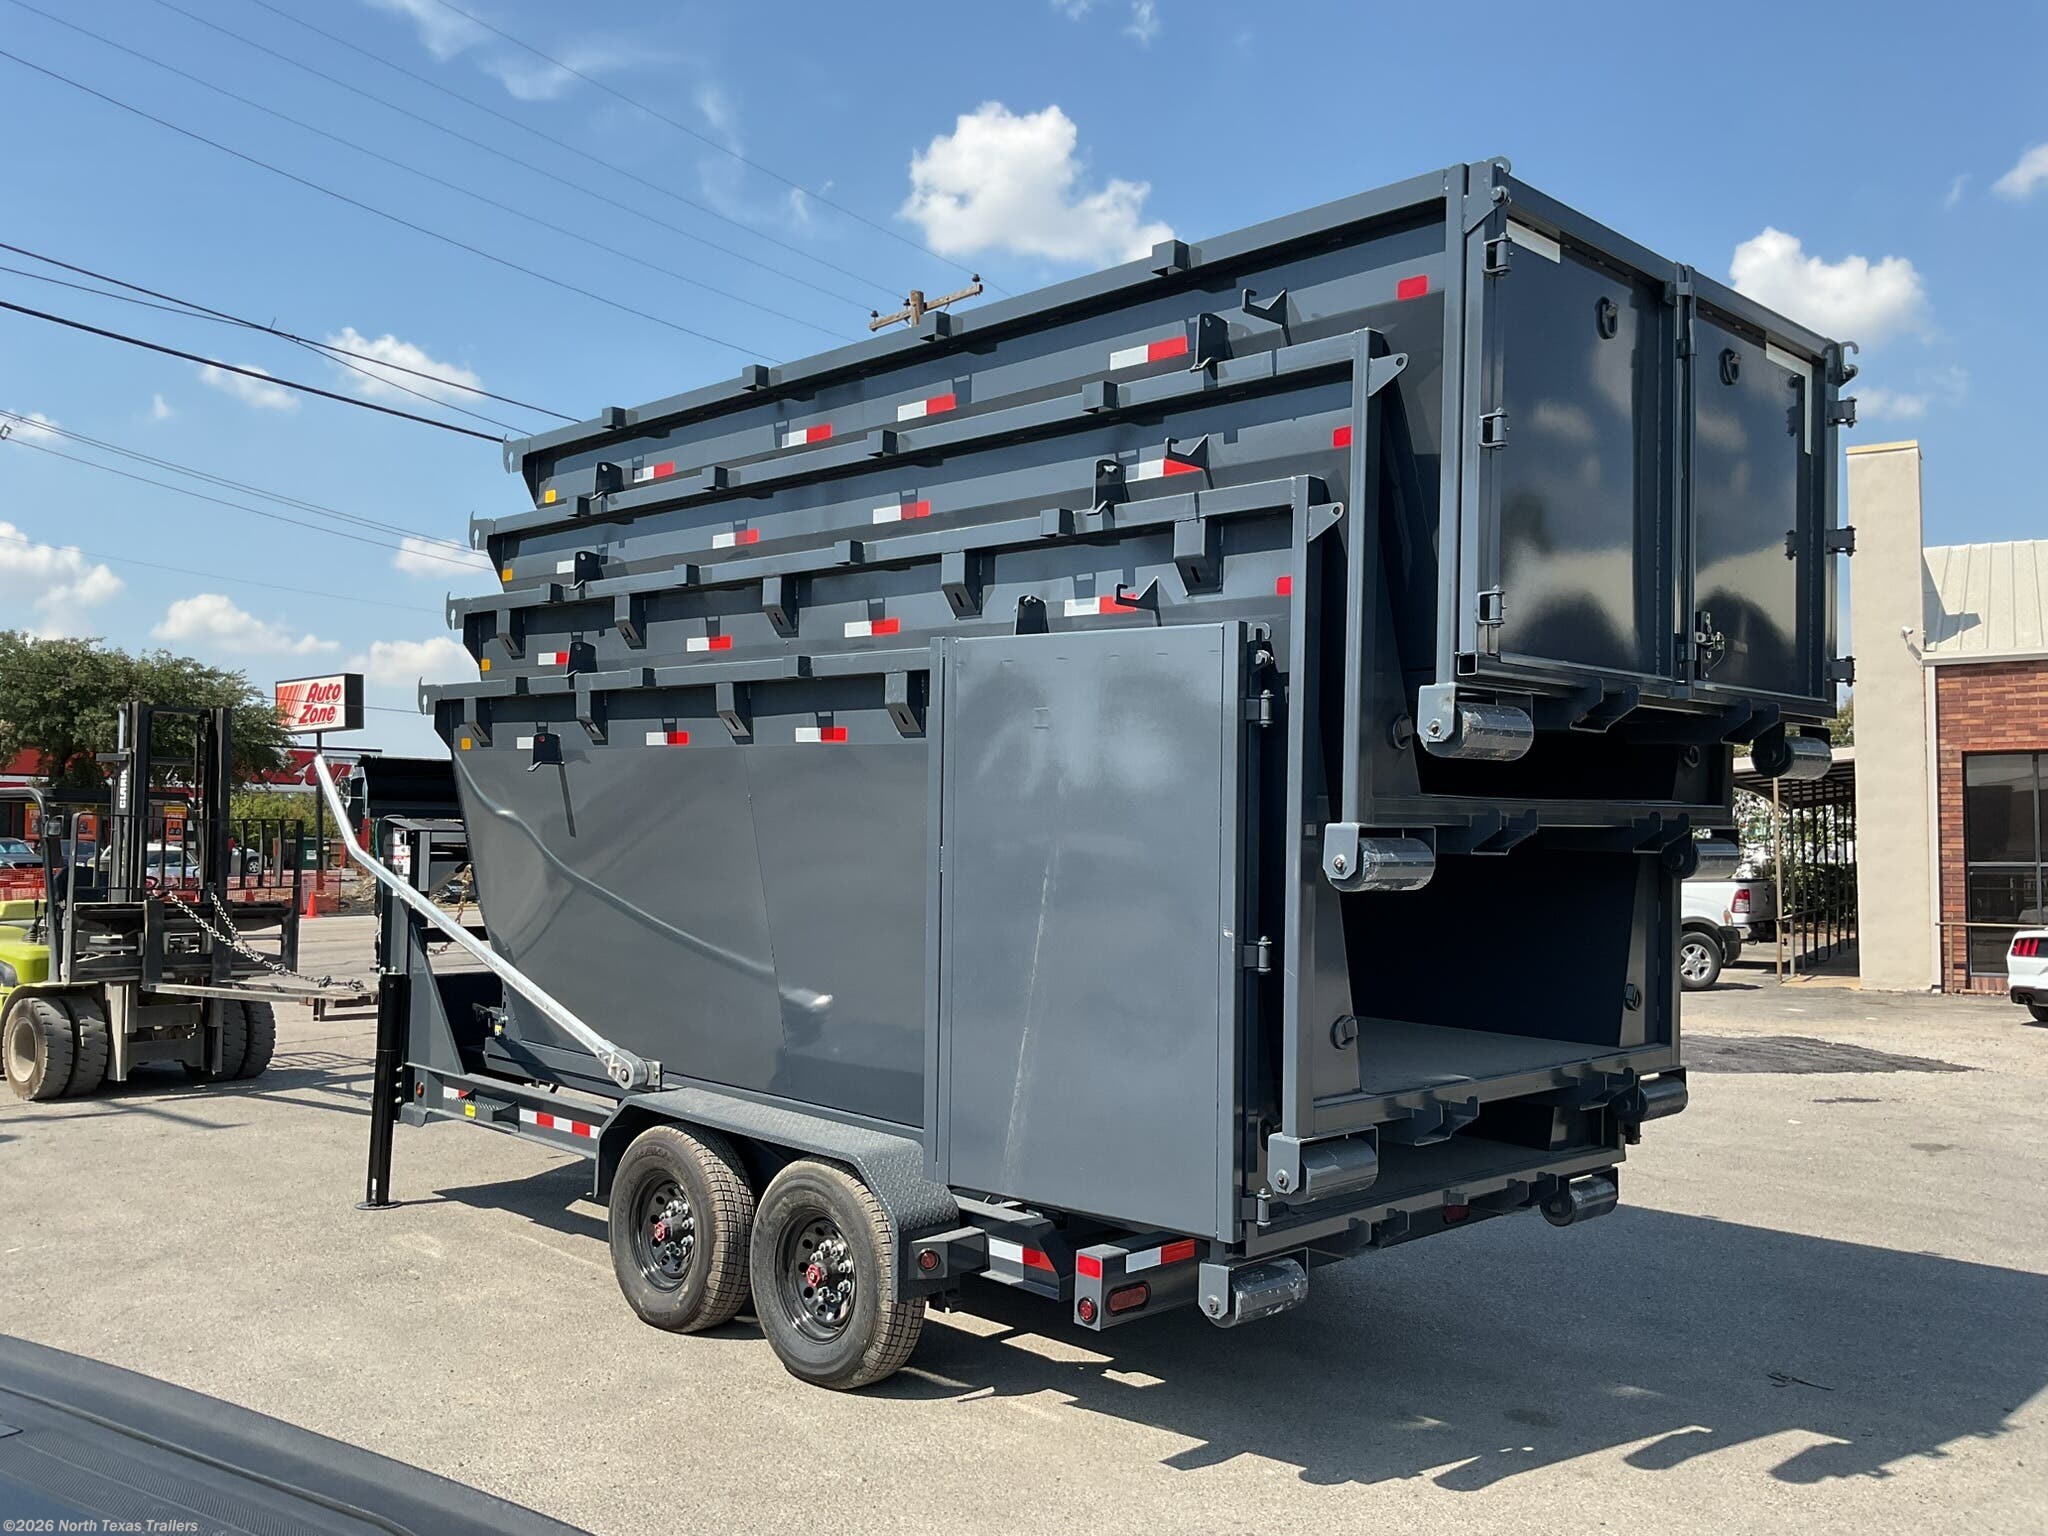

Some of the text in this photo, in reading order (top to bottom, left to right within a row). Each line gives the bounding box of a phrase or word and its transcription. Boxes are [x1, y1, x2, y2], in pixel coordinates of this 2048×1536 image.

[306, 682, 342, 703] Auto
[298, 704, 337, 724] Zone
[119, 769, 128, 808] CLARK
